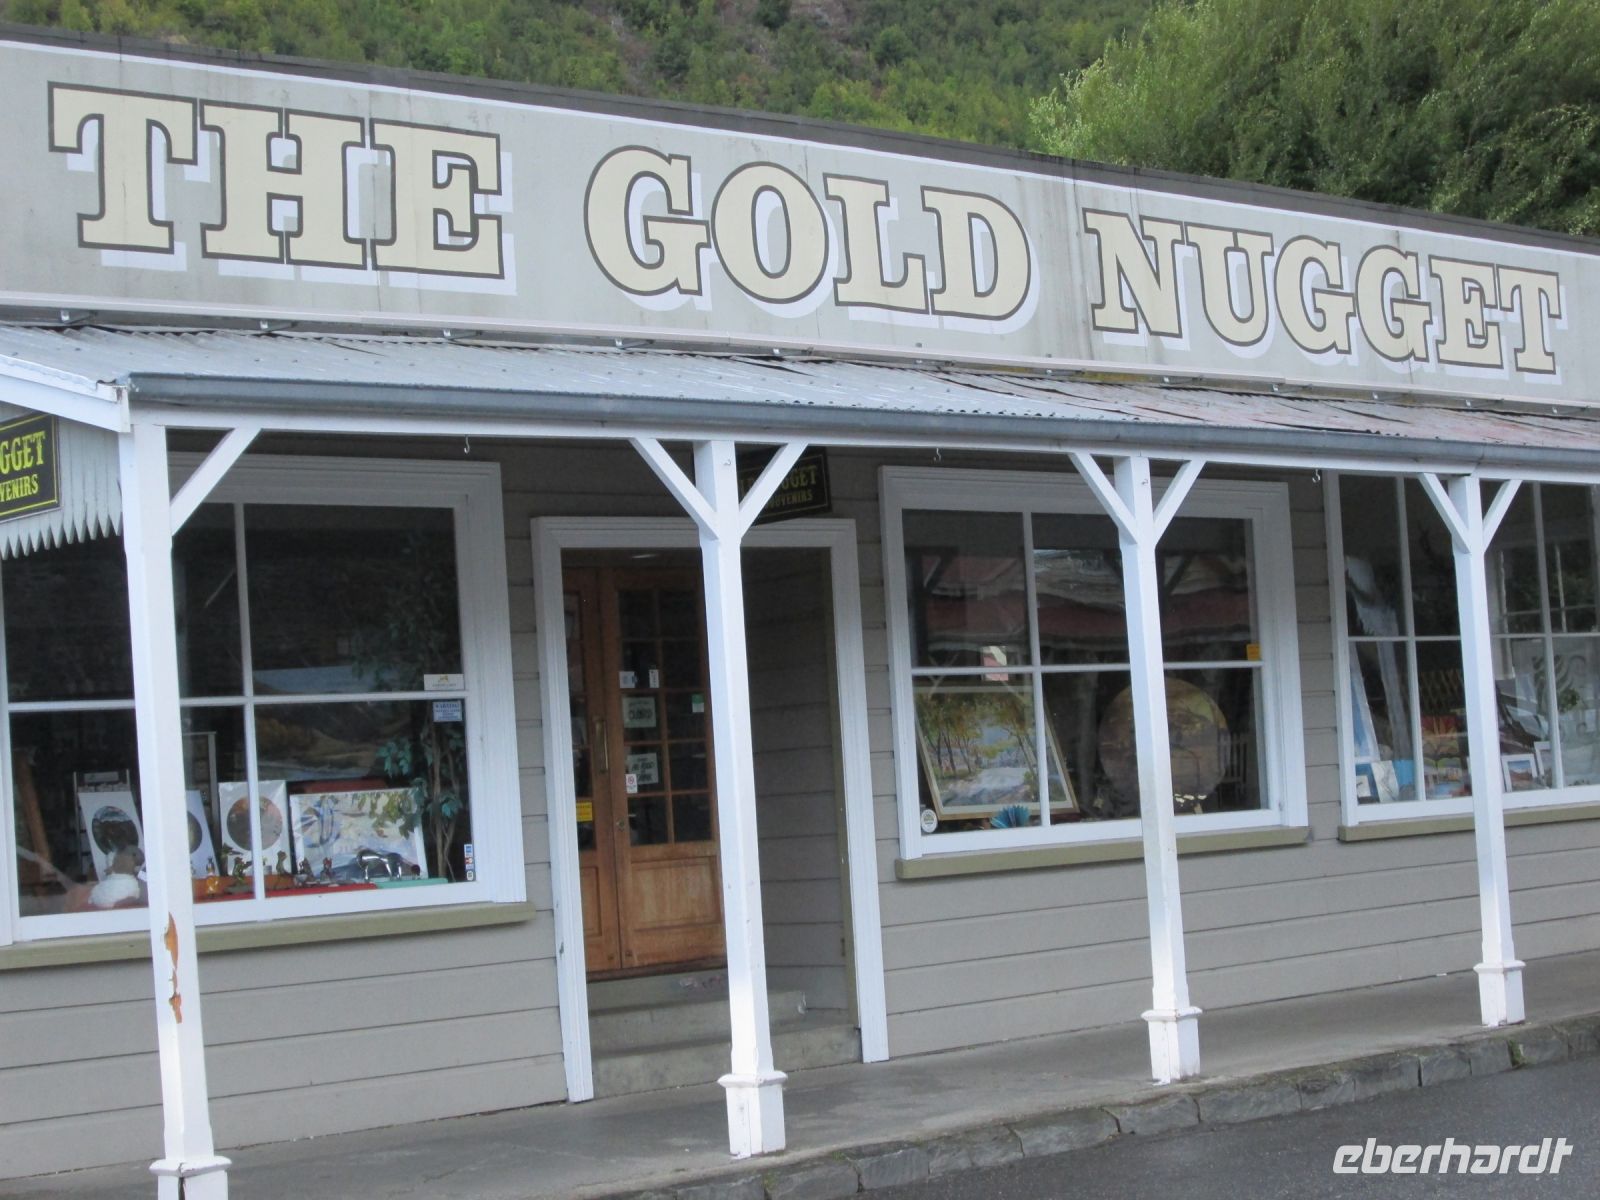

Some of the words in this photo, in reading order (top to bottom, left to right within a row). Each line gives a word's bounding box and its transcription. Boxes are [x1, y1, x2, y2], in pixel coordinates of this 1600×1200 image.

[48, 81, 505, 280] THE
[584, 145, 1031, 321] GOLD
[1083, 207, 1562, 375] NUGGET
